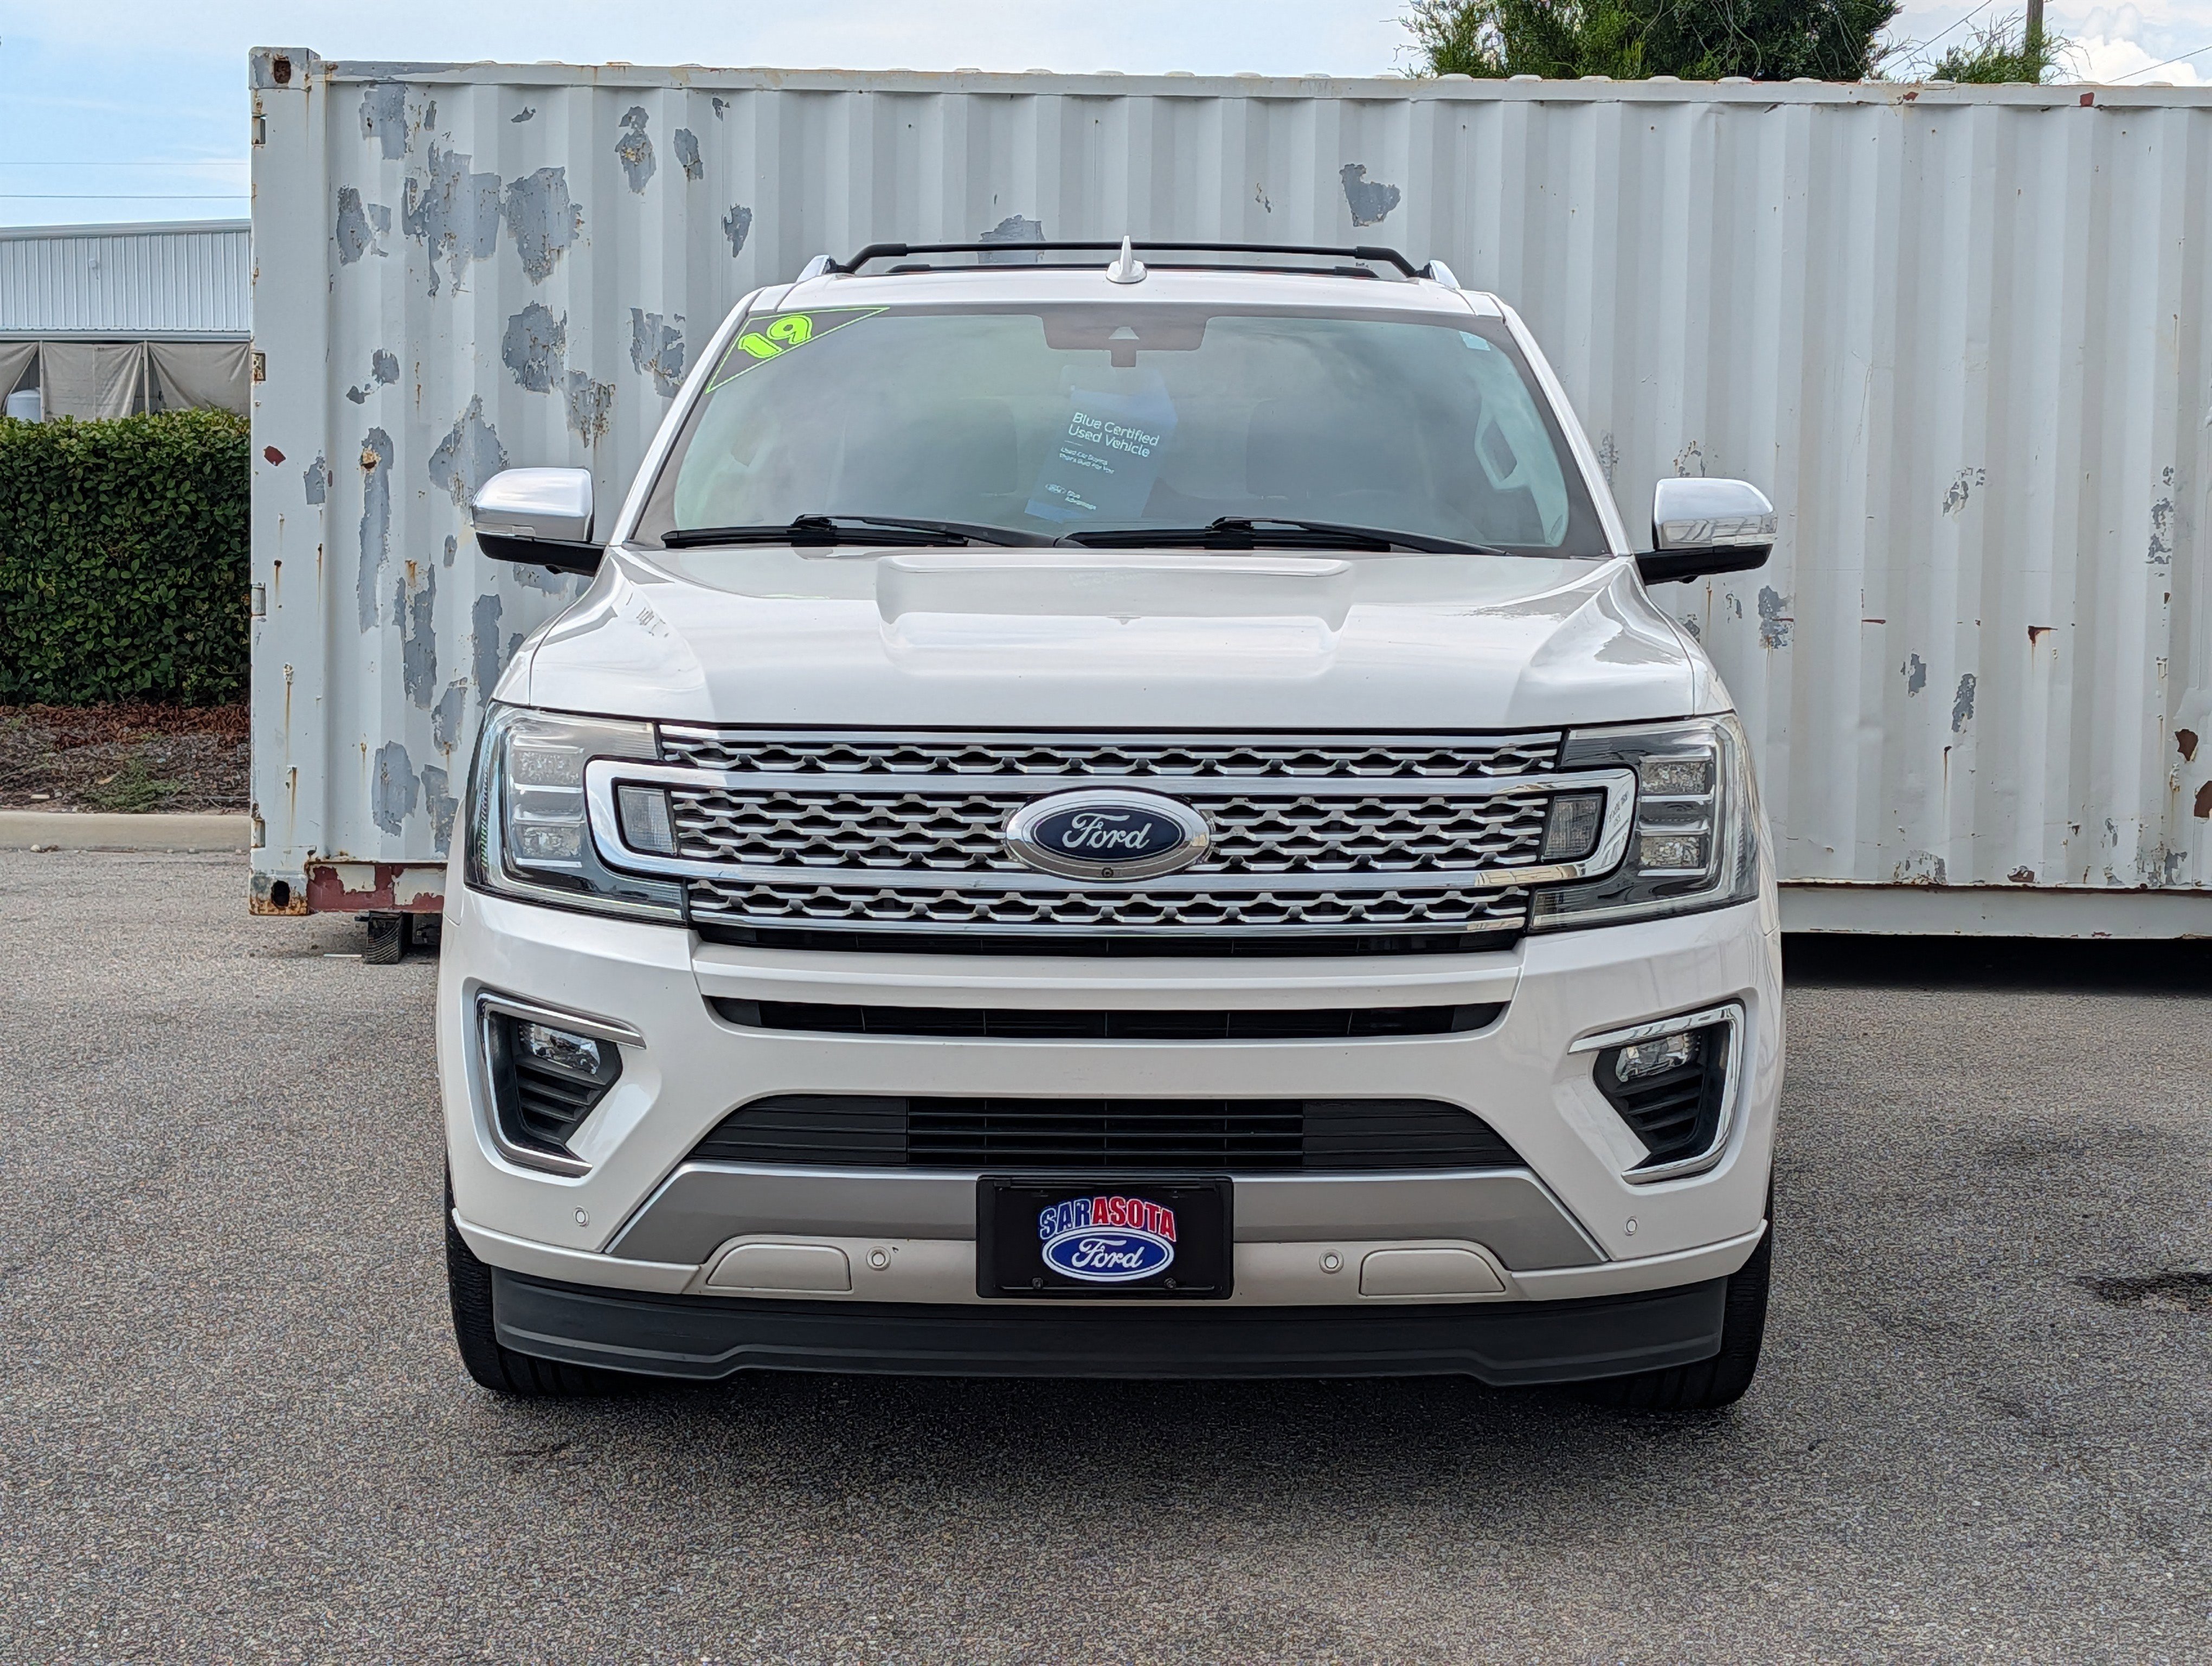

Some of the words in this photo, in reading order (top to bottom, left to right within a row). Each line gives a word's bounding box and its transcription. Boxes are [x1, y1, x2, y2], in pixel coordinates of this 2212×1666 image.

[738, 315, 812, 358] 19
[1068, 424, 1103, 443] Used
[1105, 434, 1150, 457] Vehicle
[1072, 412, 1102, 429] Blue
[1104, 422, 1160, 446] Certified
[1062, 813, 1152, 849] Ford
[1039, 1196, 1177, 1242] SARASOTA
[1071, 1239, 1144, 1268] Ford
